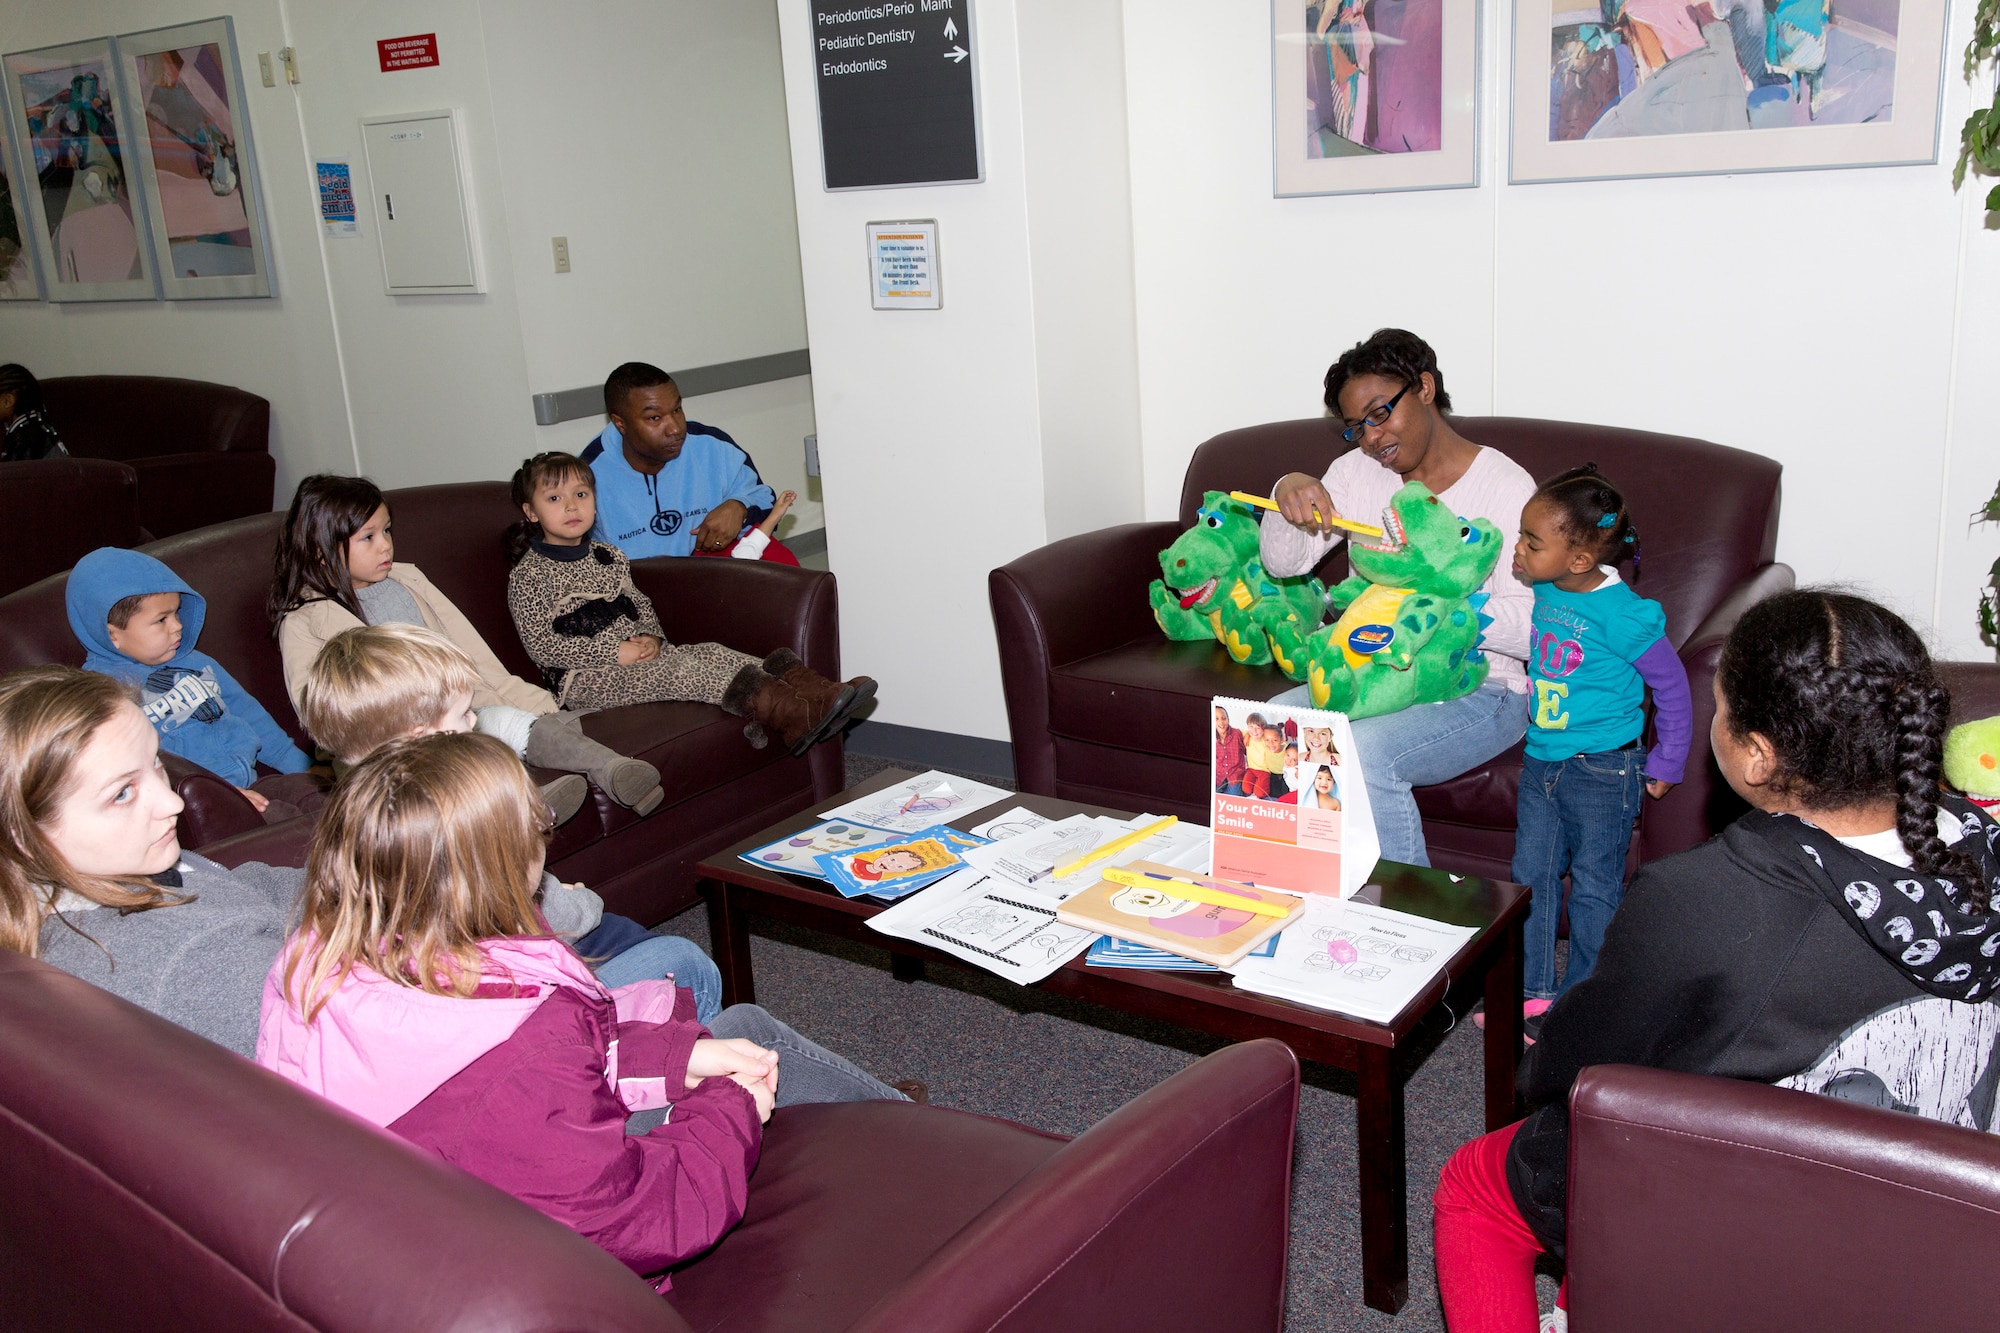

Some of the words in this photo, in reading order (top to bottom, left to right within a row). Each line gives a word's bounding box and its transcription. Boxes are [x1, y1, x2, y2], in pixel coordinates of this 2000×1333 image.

[818, 3, 914, 26] Periodontics/Perio
[920, 0, 952, 12] Maint
[405, 39, 429, 48] BEVERAGE
[819, 35, 865, 51] Pediatric
[867, 29, 916, 45] Dentistry
[400, 48, 426, 57] PERMITTED
[401, 58, 420, 66] WAITING
[823, 58, 888, 76] Endodontics
[327, 178, 349, 193] gold
[321, 190, 352, 201] medal
[322, 201, 354, 214] smile
[618, 527, 647, 540] NAUTICA
[1217, 799, 1248, 813] Your
[1251, 804, 1296, 822] Child's
[1217, 814, 1254, 830] Smile
[1369, 926, 1382, 934] How
[1391, 930, 1407, 939] Floss
